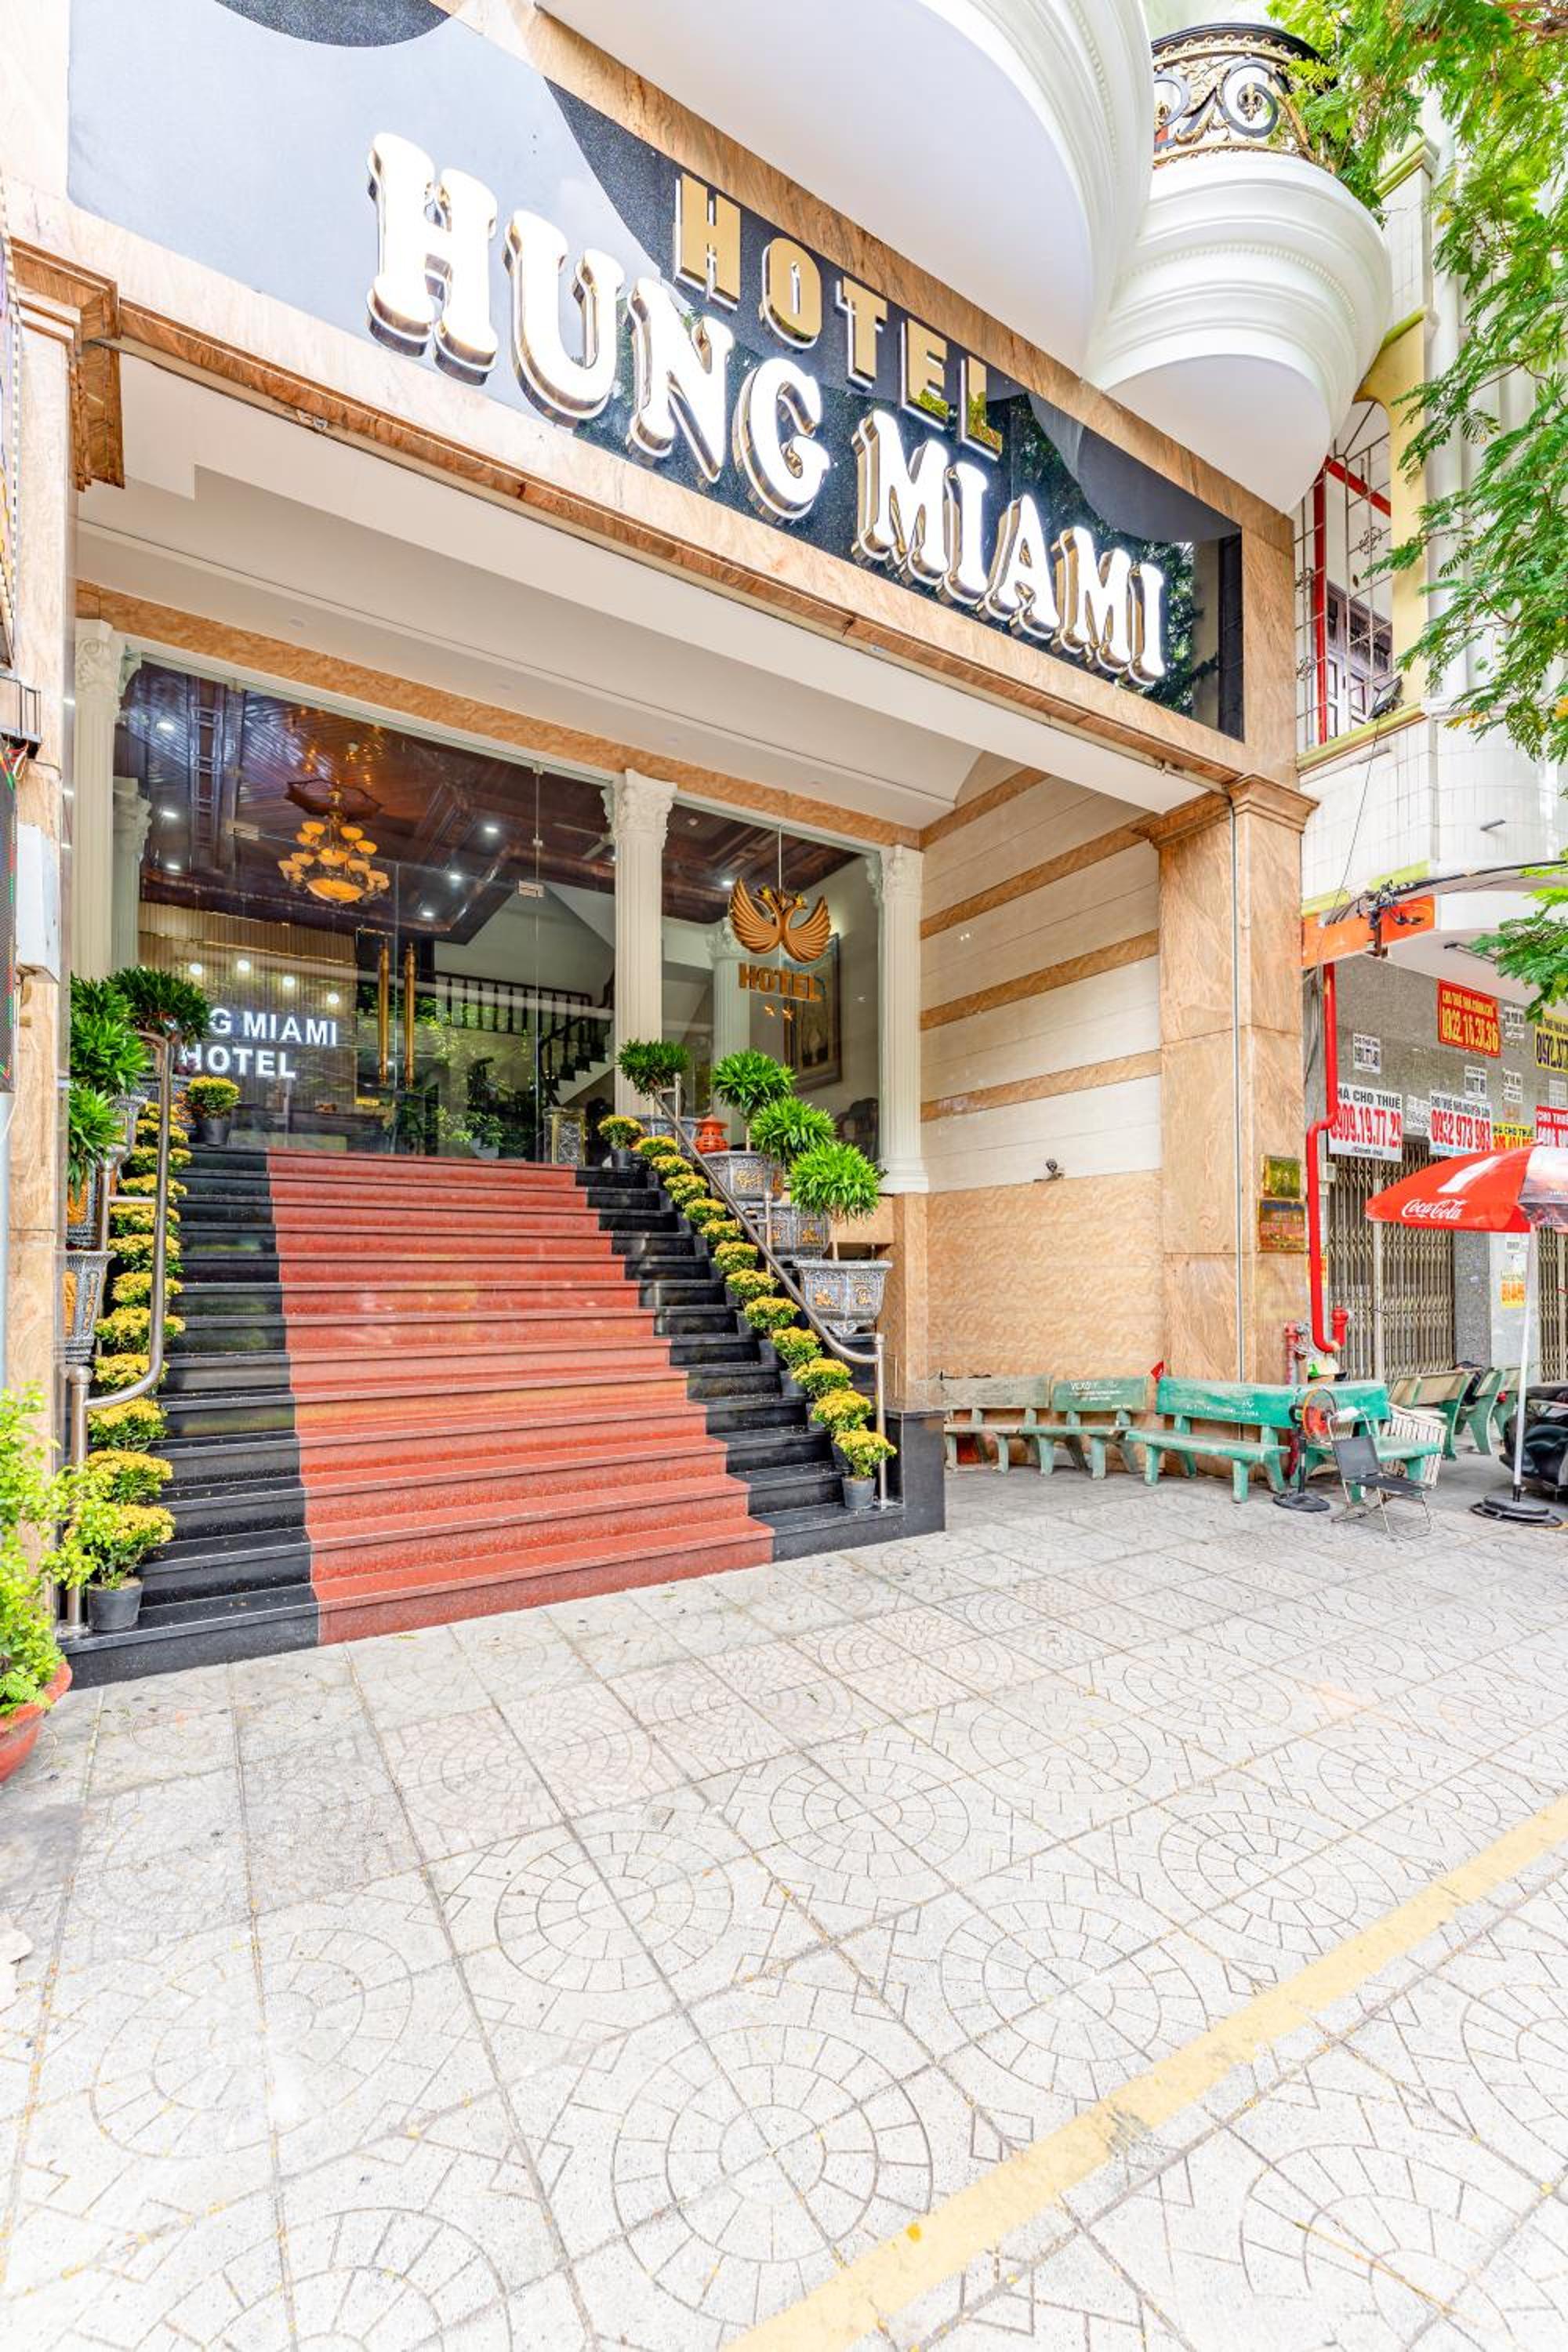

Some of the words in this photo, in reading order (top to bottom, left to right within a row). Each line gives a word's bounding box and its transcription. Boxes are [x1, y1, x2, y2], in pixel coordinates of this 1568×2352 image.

[674, 172, 1002, 460] HOTEL
[367, 132, 831, 519] HUNG
[852, 409, 1166, 686] MIAMI
[738, 961, 822, 1003] HOTEL
[243, 1011, 337, 1047] MIAMI
[179, 1044, 296, 1078] HOTEL
[1337, 1085, 1350, 1101] HÀ
[1353, 1090, 1374, 1105] CHO
